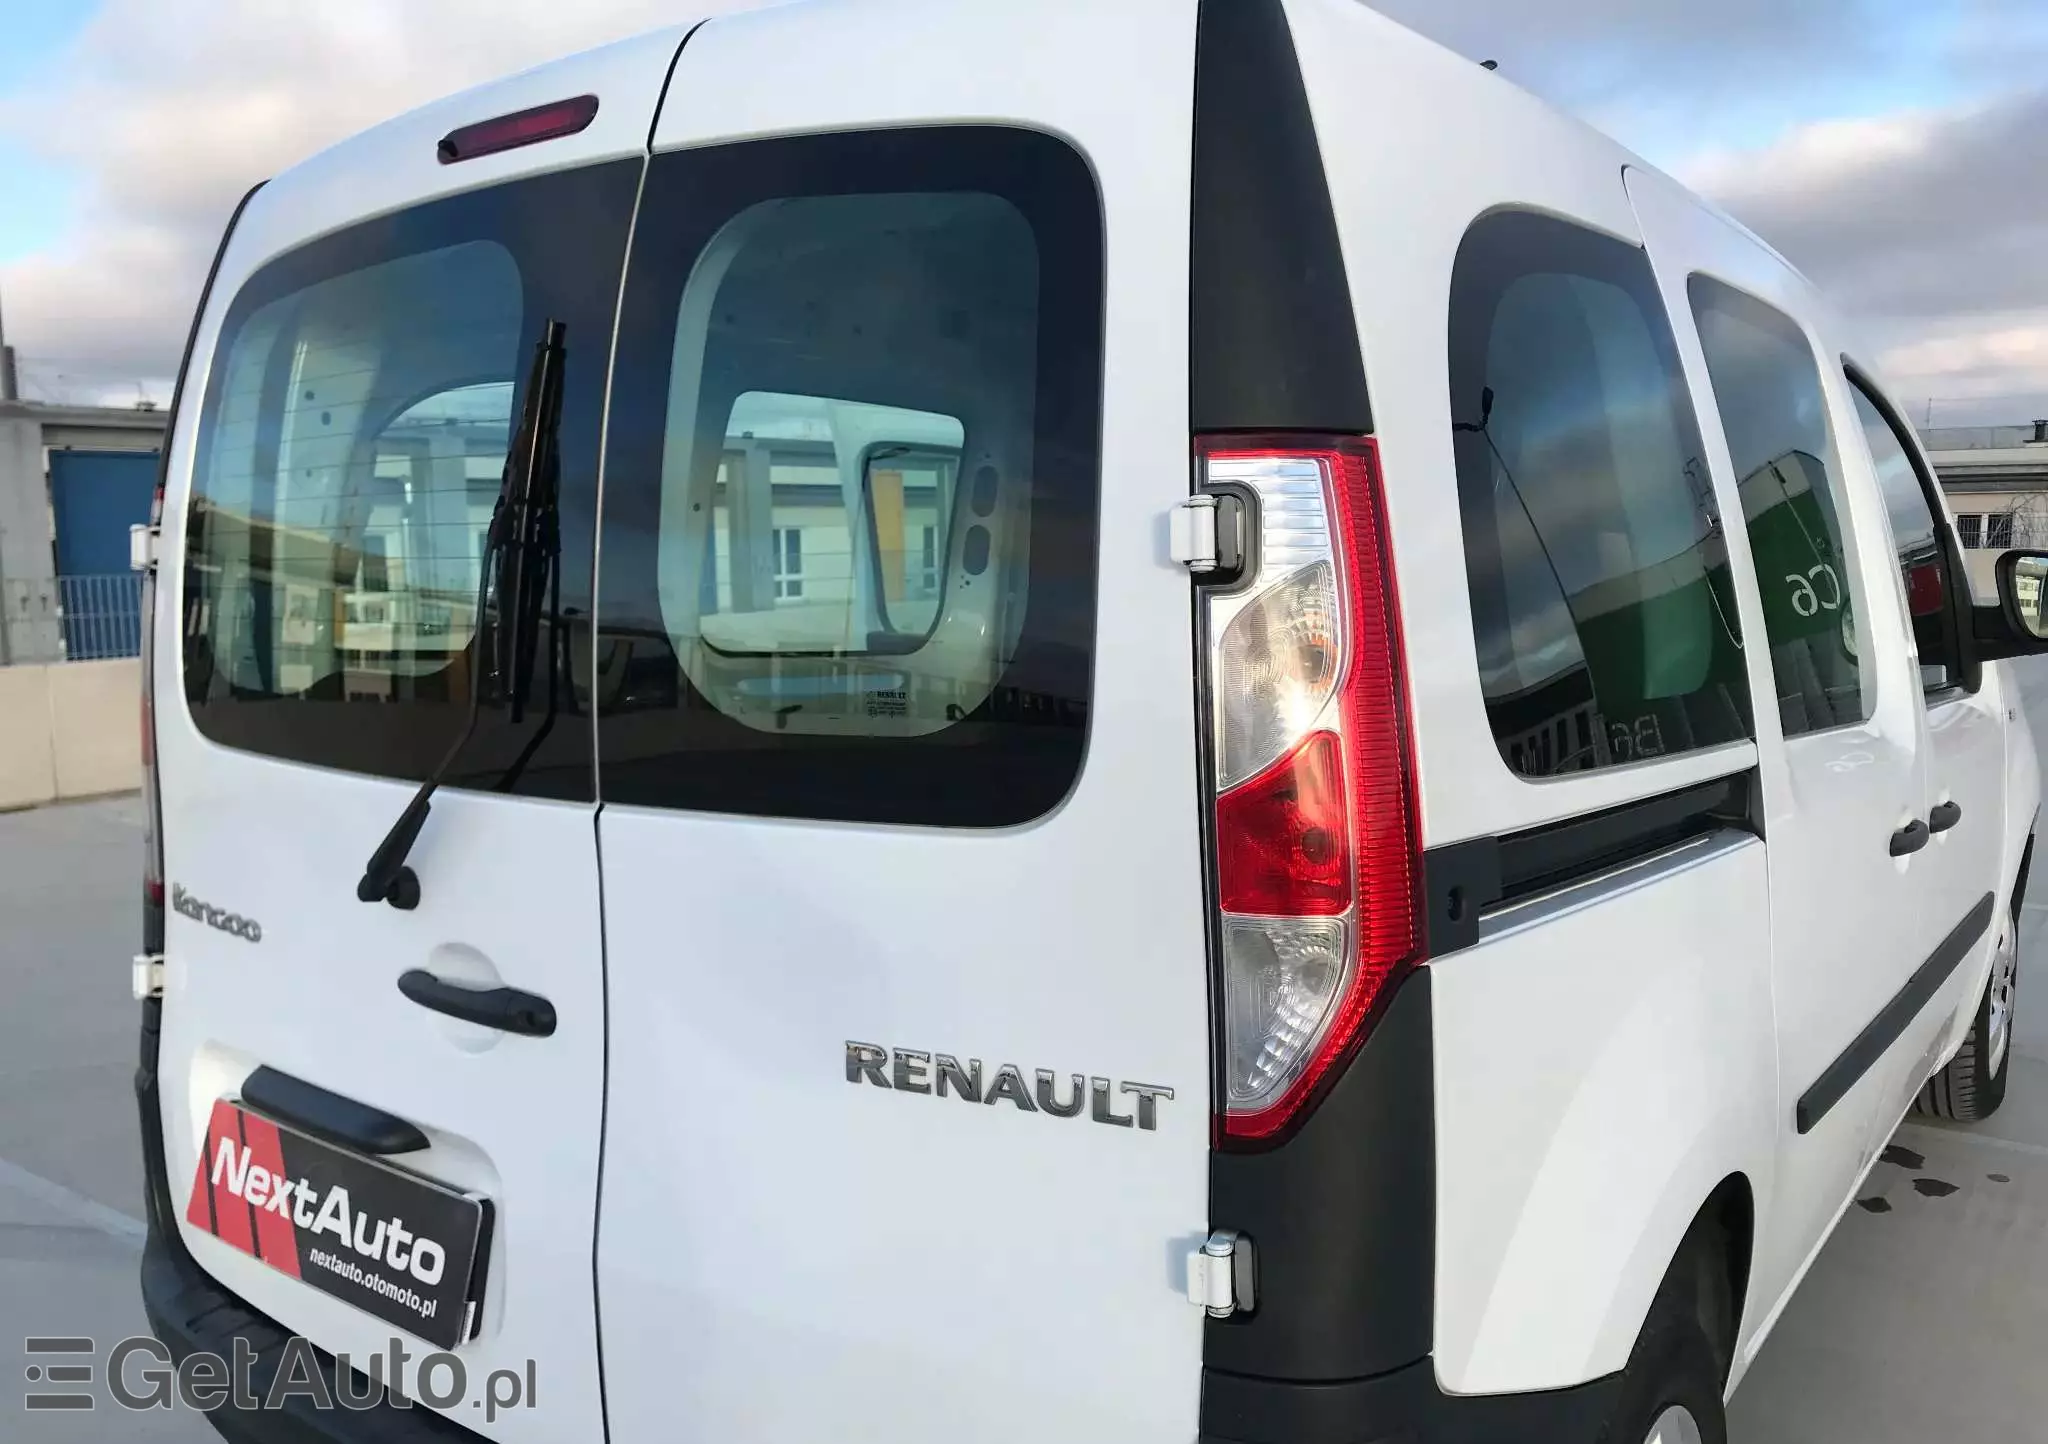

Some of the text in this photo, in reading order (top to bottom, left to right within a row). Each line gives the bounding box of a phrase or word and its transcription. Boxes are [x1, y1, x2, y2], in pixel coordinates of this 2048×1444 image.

[845, 1039, 1175, 1131] RENAULT
[211, 1136, 445, 1286] NextAuto
[309, 1248, 438, 1318] nextauto.otomoto.pl
